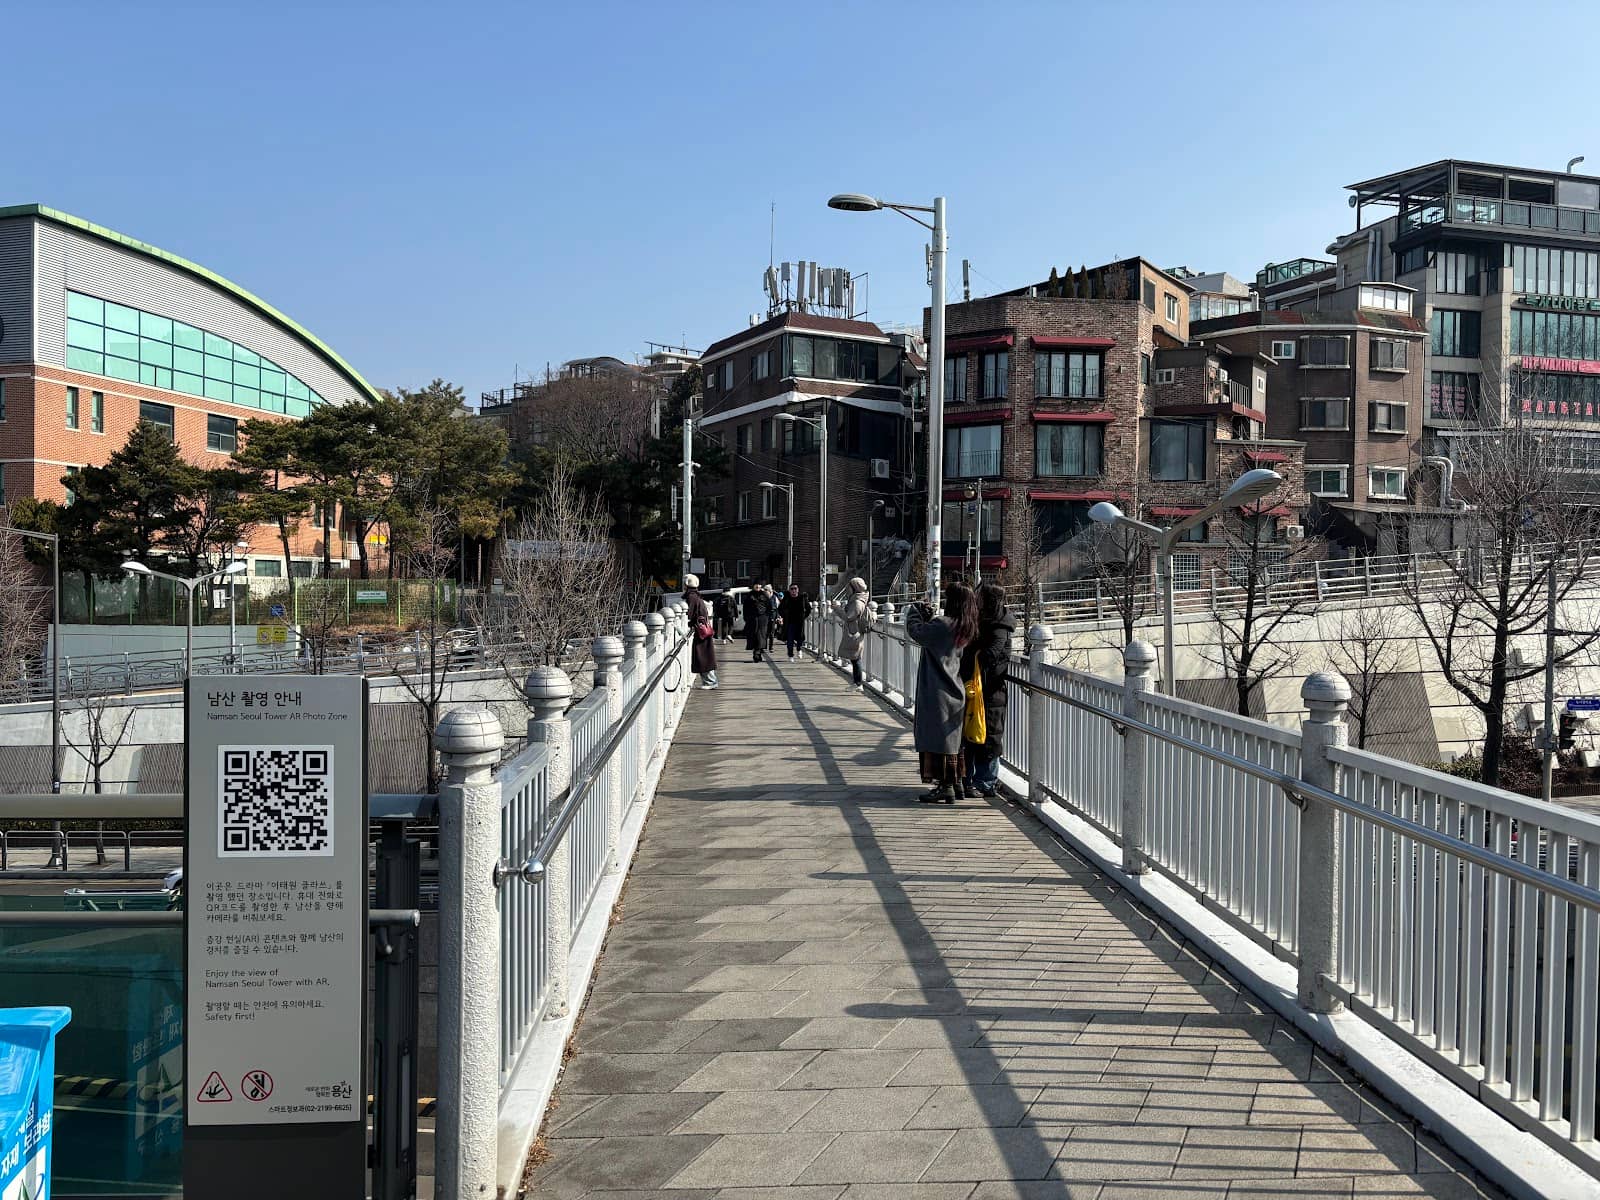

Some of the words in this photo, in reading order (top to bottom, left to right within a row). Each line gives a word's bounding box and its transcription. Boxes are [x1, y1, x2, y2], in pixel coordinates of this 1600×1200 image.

[207, 691, 236, 707] 남산
[241, 691, 268, 707] 촬영
[274, 691, 302, 707] 안내
[207, 712, 239, 720] Namsan
[240, 712, 262, 720] Seoul
[264, 712, 288, 720] Tower
[289, 712, 301, 720] AR
[303, 712, 326, 720] Photo
[328, 712, 348, 720] Zone
[206, 881, 232, 891] 이곳은
[236, 881, 263, 890] 드라마
[298, 891, 314, 901] 휴대
[206, 902, 248, 912] QR코드를
[295, 901, 321, 911] 남산을
[206, 913, 239, 923] 카메라를
[319, 932, 344, 942] 남산의
[252, 945, 262, 954] 수
[263, 943, 298, 954] 있습니다.
[205, 969, 229, 979] Enjoy
[231, 969, 246, 977] the
[248, 969, 267, 977] view
[269, 968, 279, 977] of
[205, 980, 239, 988] Namsan
[241, 979, 265, 987] Seoul
[268, 979, 293, 987] Tower
[295, 978, 313, 986] with
[233, 1000, 250, 1011] 때는
[253, 1000, 278, 1010] 안전에
[205, 1012, 232, 1021] Safety
[235, 1012, 255, 1020] first!
[331, 1085, 352, 1099] 용산
[23, 1109, 51, 1155] 보관함
